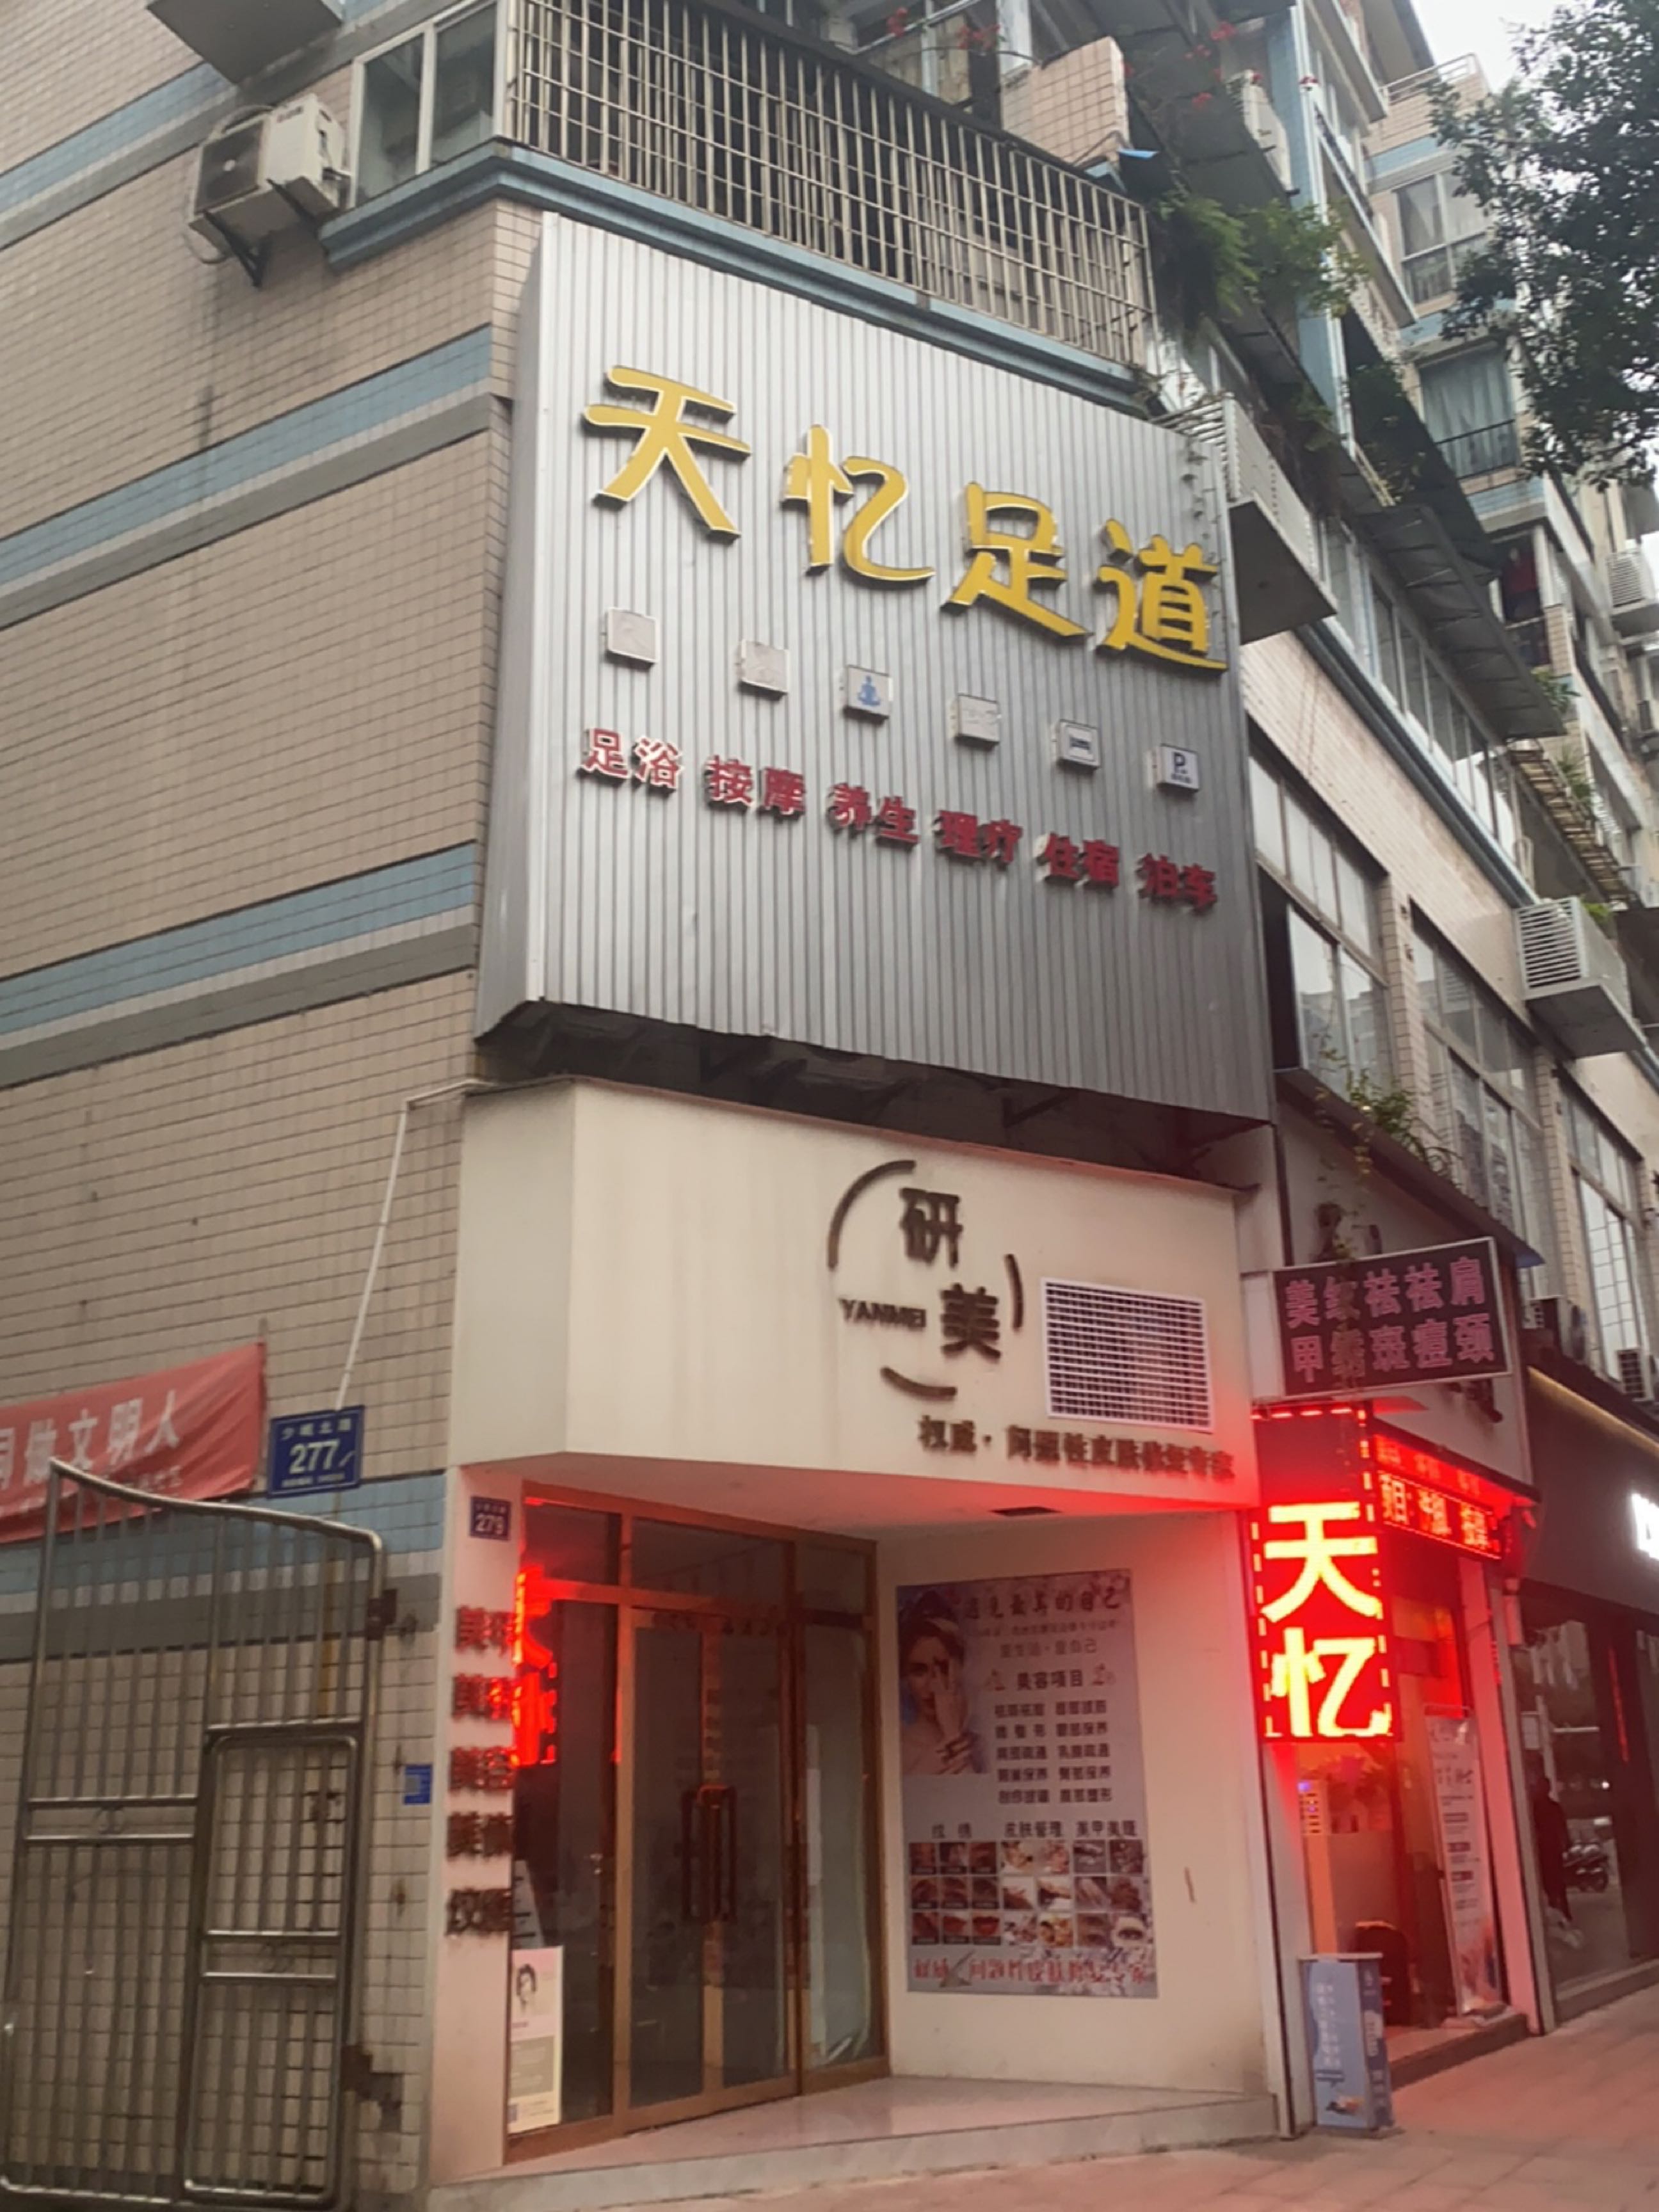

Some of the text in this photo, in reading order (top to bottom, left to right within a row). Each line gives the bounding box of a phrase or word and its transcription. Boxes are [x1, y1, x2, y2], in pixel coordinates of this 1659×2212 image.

[584, 365, 1227, 671] 天忆足道
[581, 728, 682, 788] 足浴
[706, 755, 806, 815] 按摩
[828, 783, 919, 845] 养生
[934, 810, 1022, 864] 理疗
[1041, 832, 1119, 888] 住宿
[838, 1299, 926, 1328] YANMEI
[289, 1439, 340, 1474] 277
[1261, 1501, 1391, 1737] 天忆
